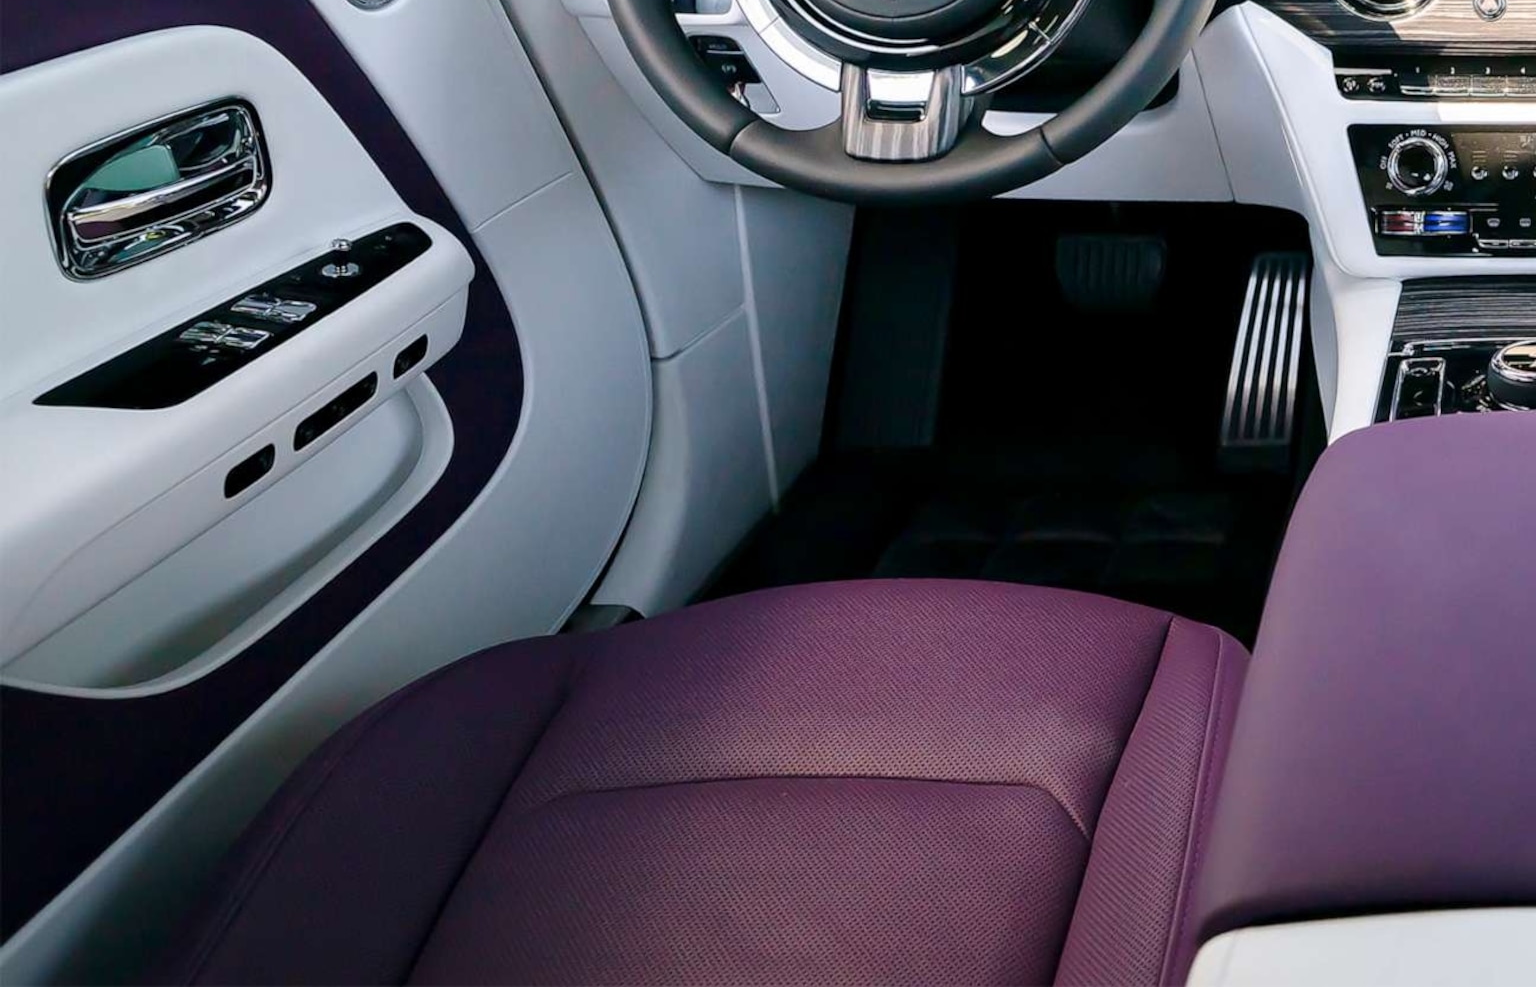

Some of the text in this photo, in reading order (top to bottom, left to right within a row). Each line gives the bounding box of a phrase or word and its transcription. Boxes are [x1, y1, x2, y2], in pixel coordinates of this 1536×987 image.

[1380, 129, 1457, 170] OFF SOFT MED HIGH MAX
